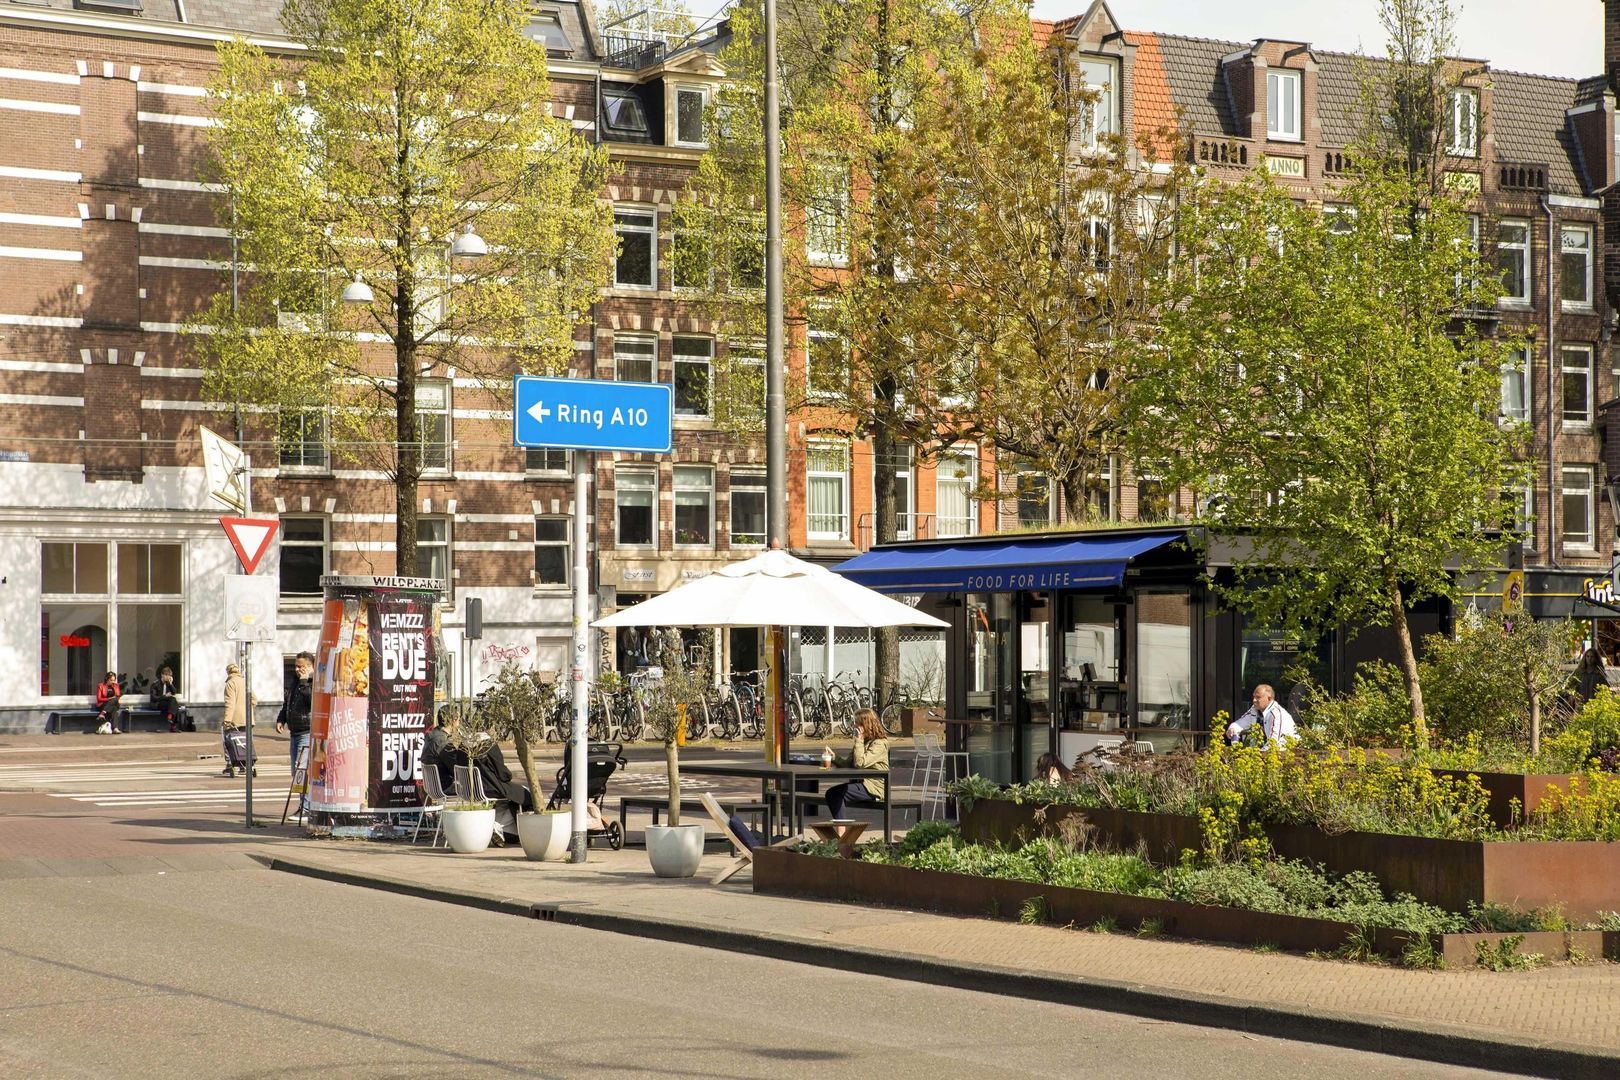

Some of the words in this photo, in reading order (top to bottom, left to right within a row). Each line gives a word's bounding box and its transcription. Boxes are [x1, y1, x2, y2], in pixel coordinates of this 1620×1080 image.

[1270, 158, 1300, 174] ANNO
[557, 403, 604, 430] Ring
[610, 406, 648, 427] A10
[967, 575, 1003, 589] FOOD
[1009, 574, 1035, 588] FOR
[1040, 572, 1070, 587] LIFE
[1588, 580, 1620, 604] int
[381, 632, 425, 651] RENT'S
[382, 649, 426, 680] DUE
[393, 684, 404, 693] OUT
[405, 684, 417, 693] NOW
[335, 734, 361, 753] LUST
[382, 732, 425, 751] RENT'S
[382, 749, 424, 781] DUE
[392, 785, 403, 794] OUT
[403, 785, 416, 794] NOW
